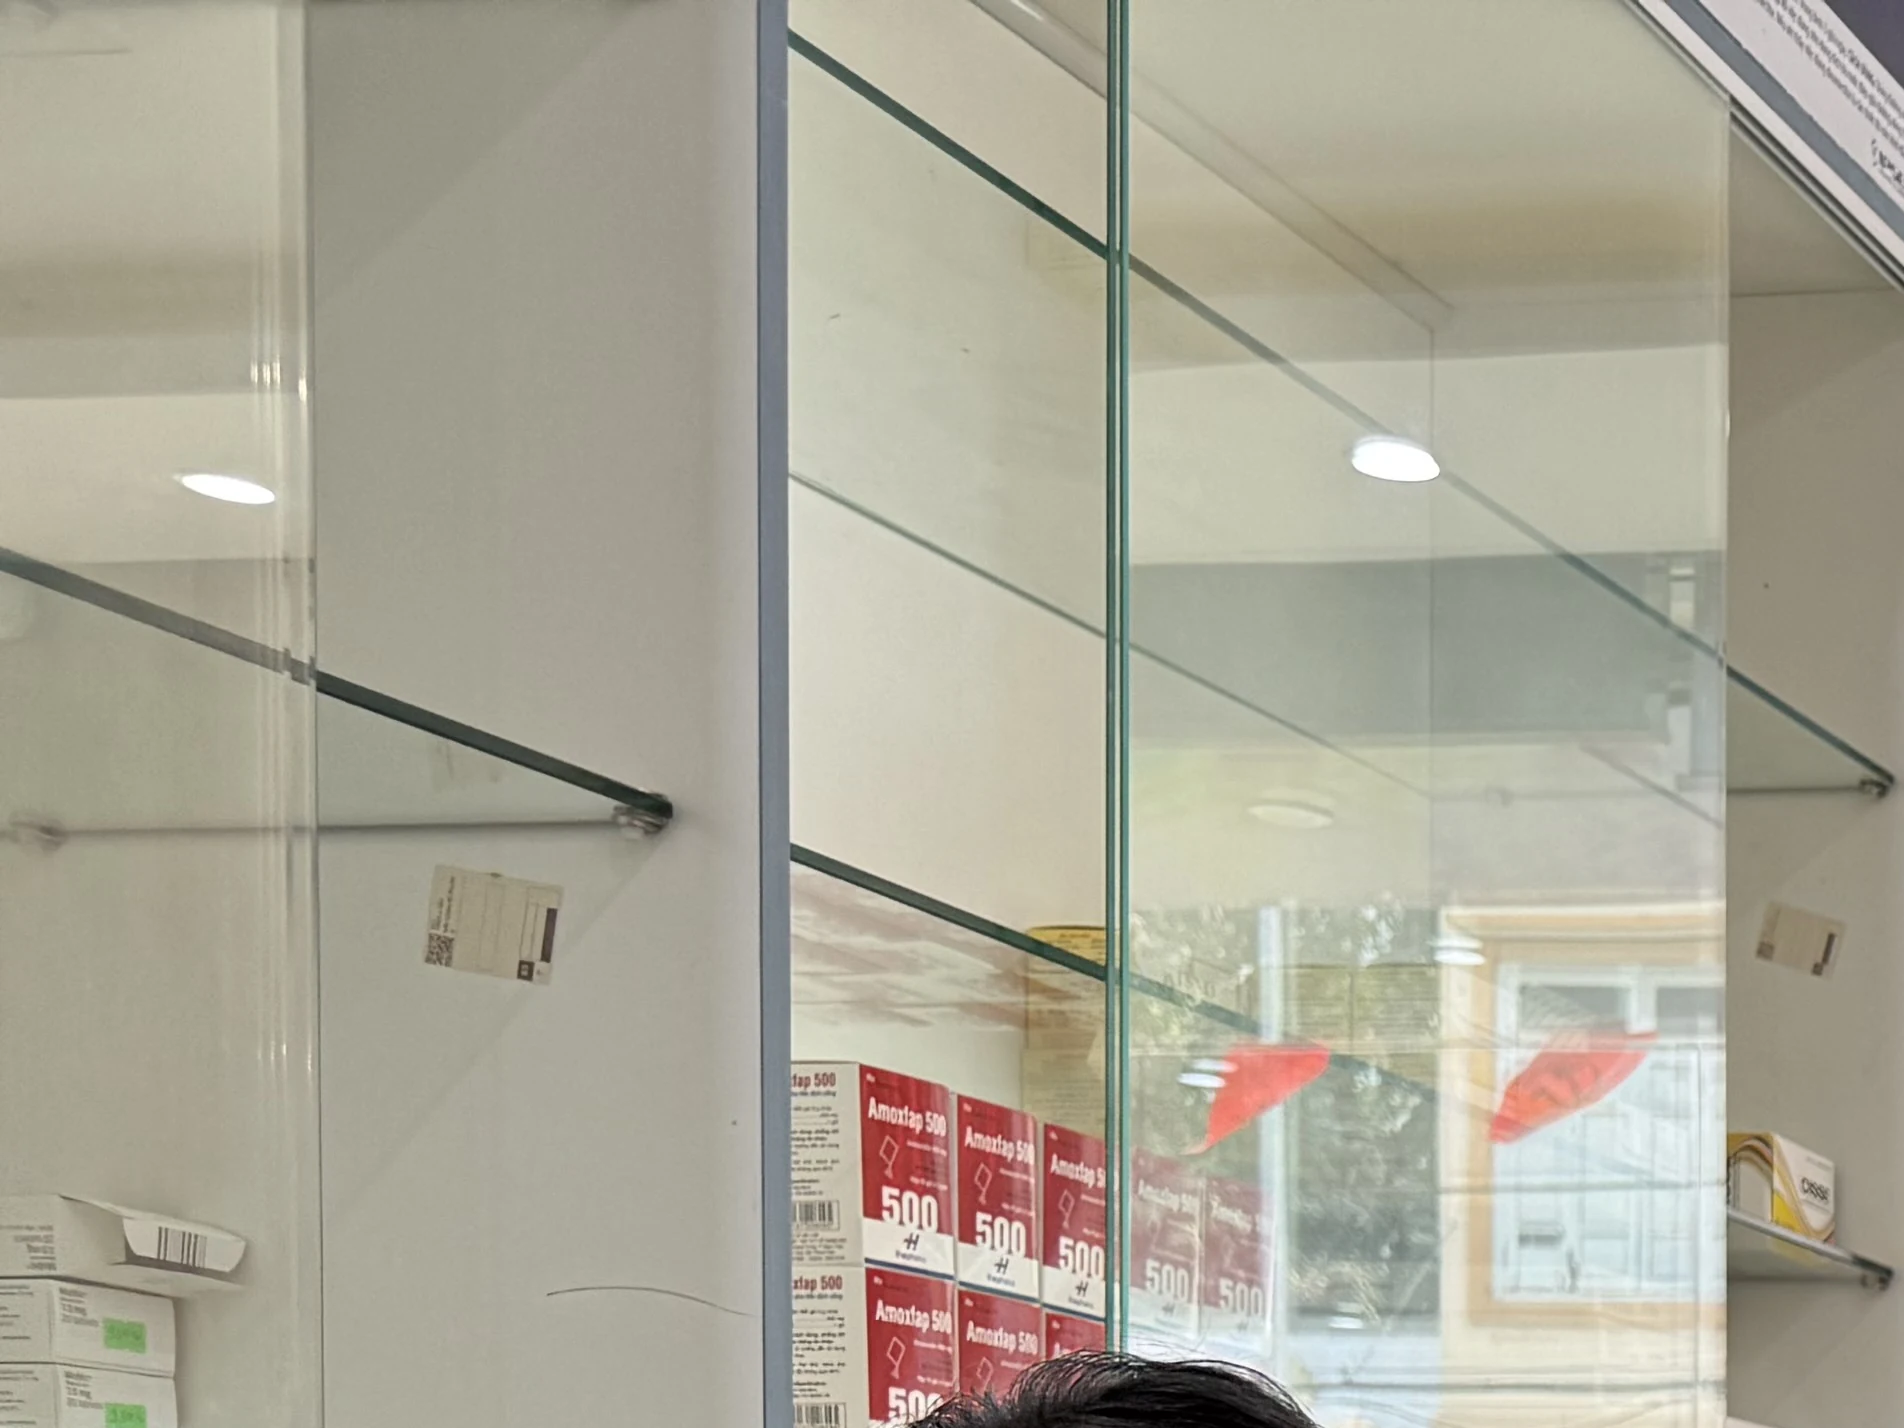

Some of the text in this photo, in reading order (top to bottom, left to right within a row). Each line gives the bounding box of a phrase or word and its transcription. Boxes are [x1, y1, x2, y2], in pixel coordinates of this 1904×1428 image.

[813, 1072, 837, 1087] 500
[925, 1112, 947, 1137] 500
[882, 1185, 938, 1234] 500
[975, 1211, 1026, 1259] 500
[1059, 1235, 1105, 1282] 500
[820, 1275, 843, 1290] 500
[1146, 1259, 1190, 1302] 500
[932, 1309, 953, 1335] 500
[1019, 1331, 1038, 1356] 500
